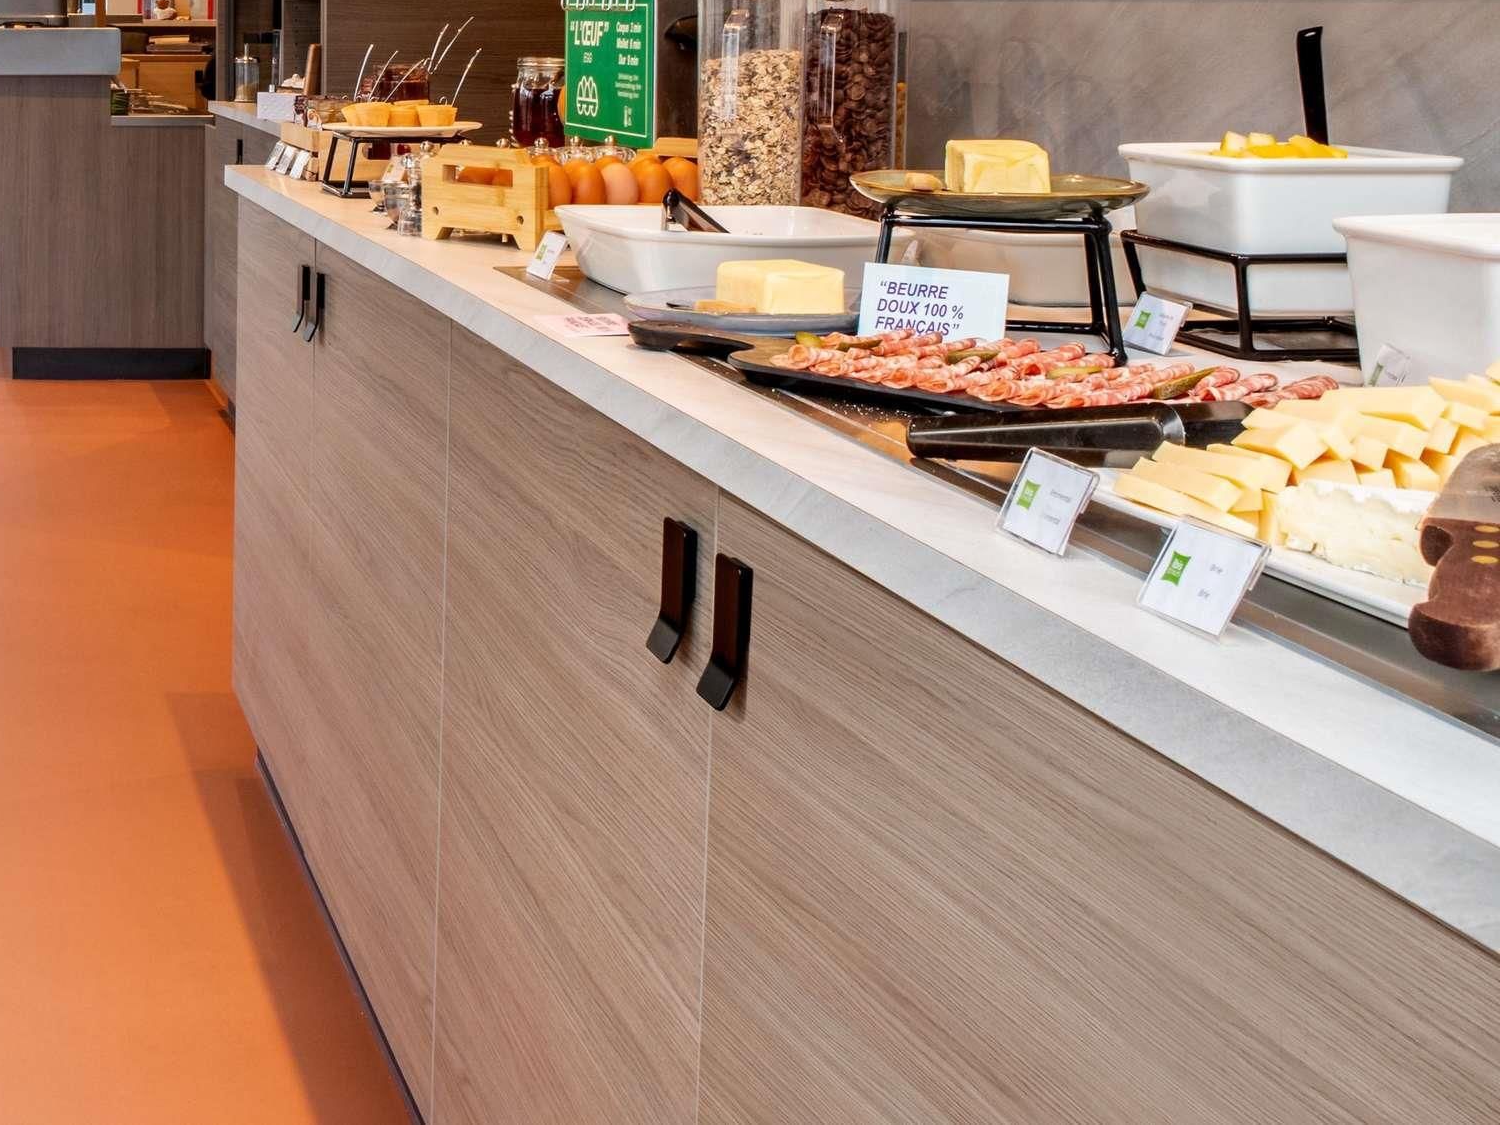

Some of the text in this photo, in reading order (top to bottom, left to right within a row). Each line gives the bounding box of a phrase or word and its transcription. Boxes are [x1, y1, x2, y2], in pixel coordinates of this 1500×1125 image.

[880, 280, 949, 300] “BEURRE
[877, 298, 964, 320] DOUX 100 %
